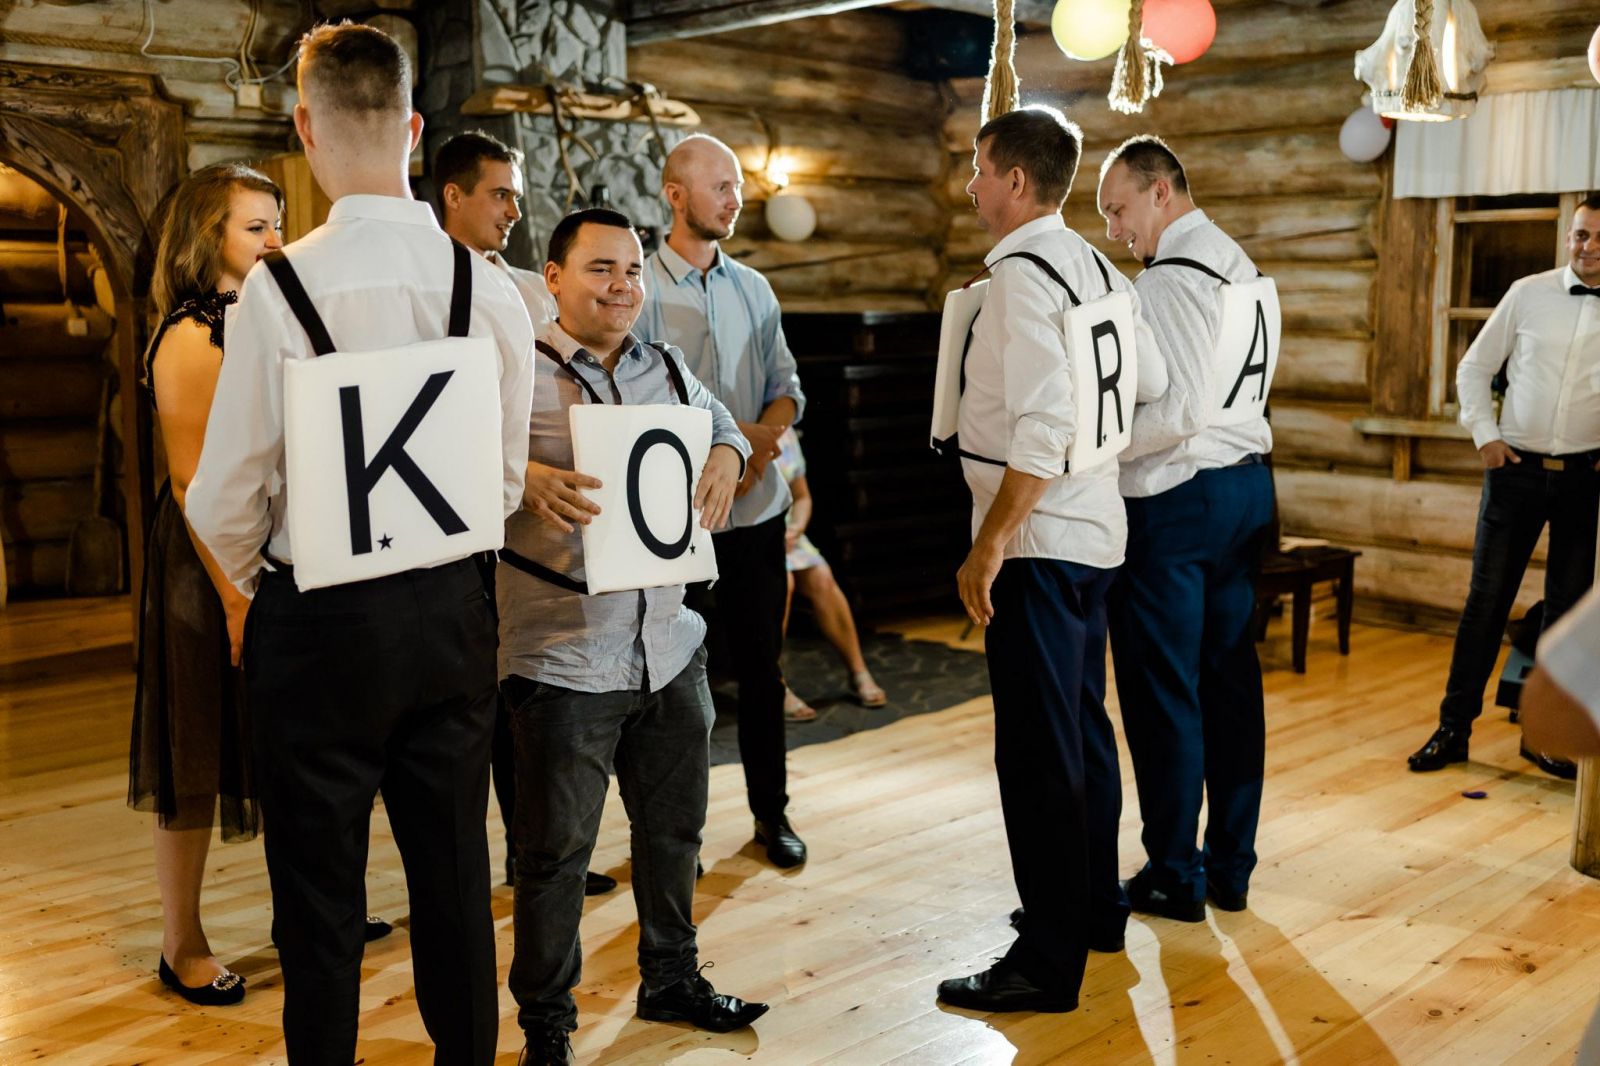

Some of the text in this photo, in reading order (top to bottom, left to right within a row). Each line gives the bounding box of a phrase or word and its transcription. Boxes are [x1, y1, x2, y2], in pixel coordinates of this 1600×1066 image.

[1091, 319, 1124, 449] R
[1223, 299, 1268, 410] A
[339, 370, 470, 556] K
[627, 428, 694, 560] O
